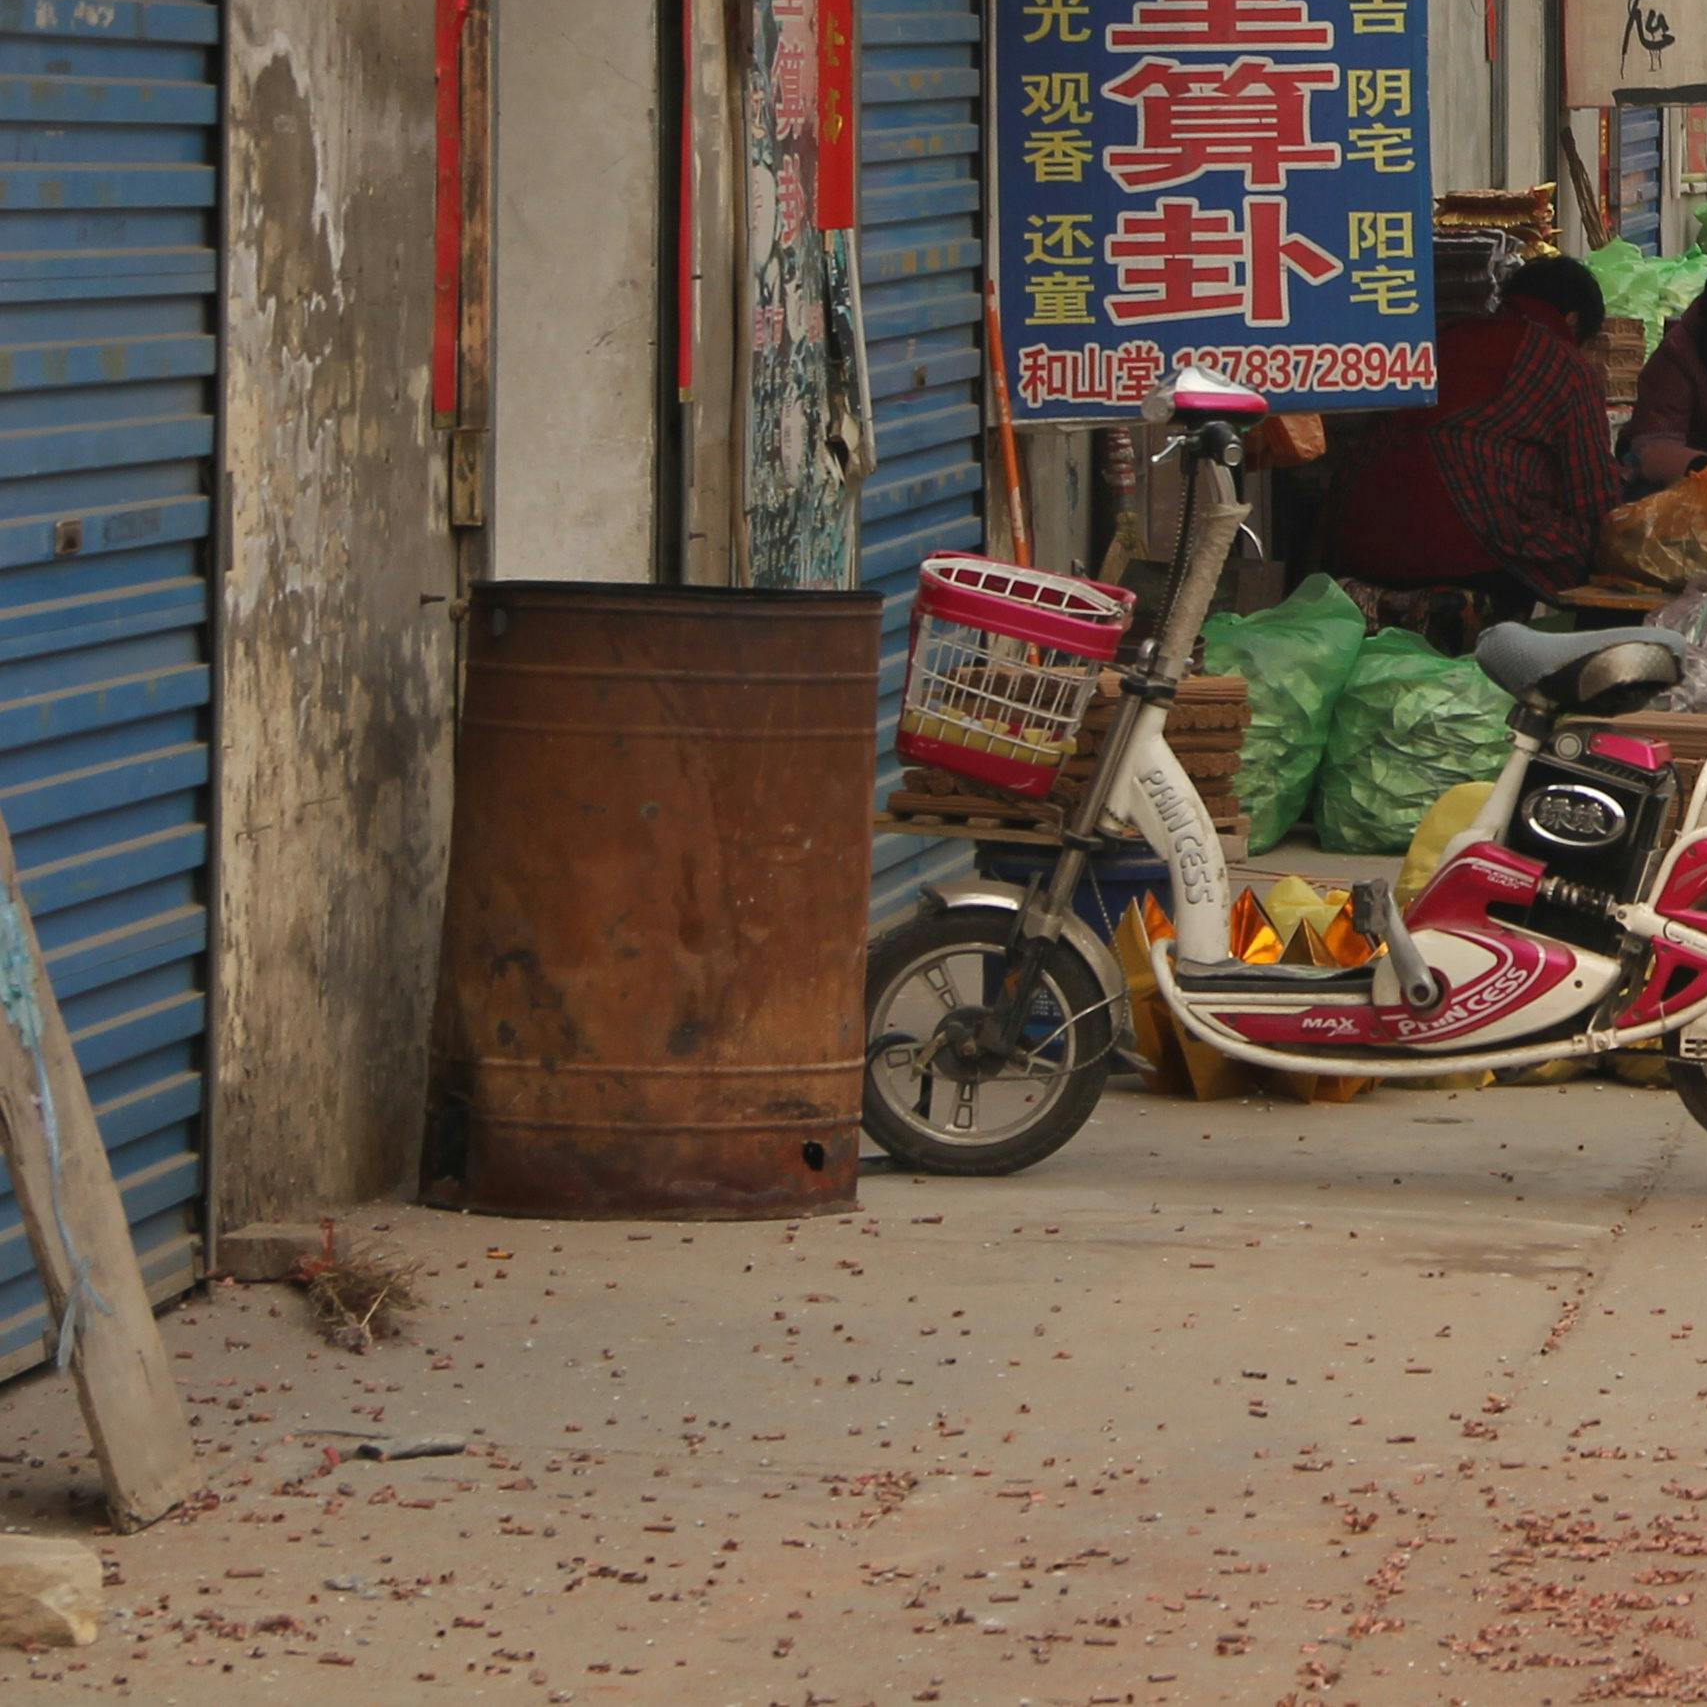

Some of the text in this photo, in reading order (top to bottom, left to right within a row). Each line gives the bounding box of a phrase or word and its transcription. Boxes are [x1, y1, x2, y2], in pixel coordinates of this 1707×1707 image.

[1021, 70, 1094, 185] 观香
[1346, 67, 1414, 175] 阴宅
[1024, 211, 1096, 327] 还童
[1348, 209, 1421, 317] 阳宅
[1019, 340, 1164, 408] 和山堂
[1301, 1017, 1355, 1036] MAX
[1397, 966, 1530, 1037] PRINCESS
